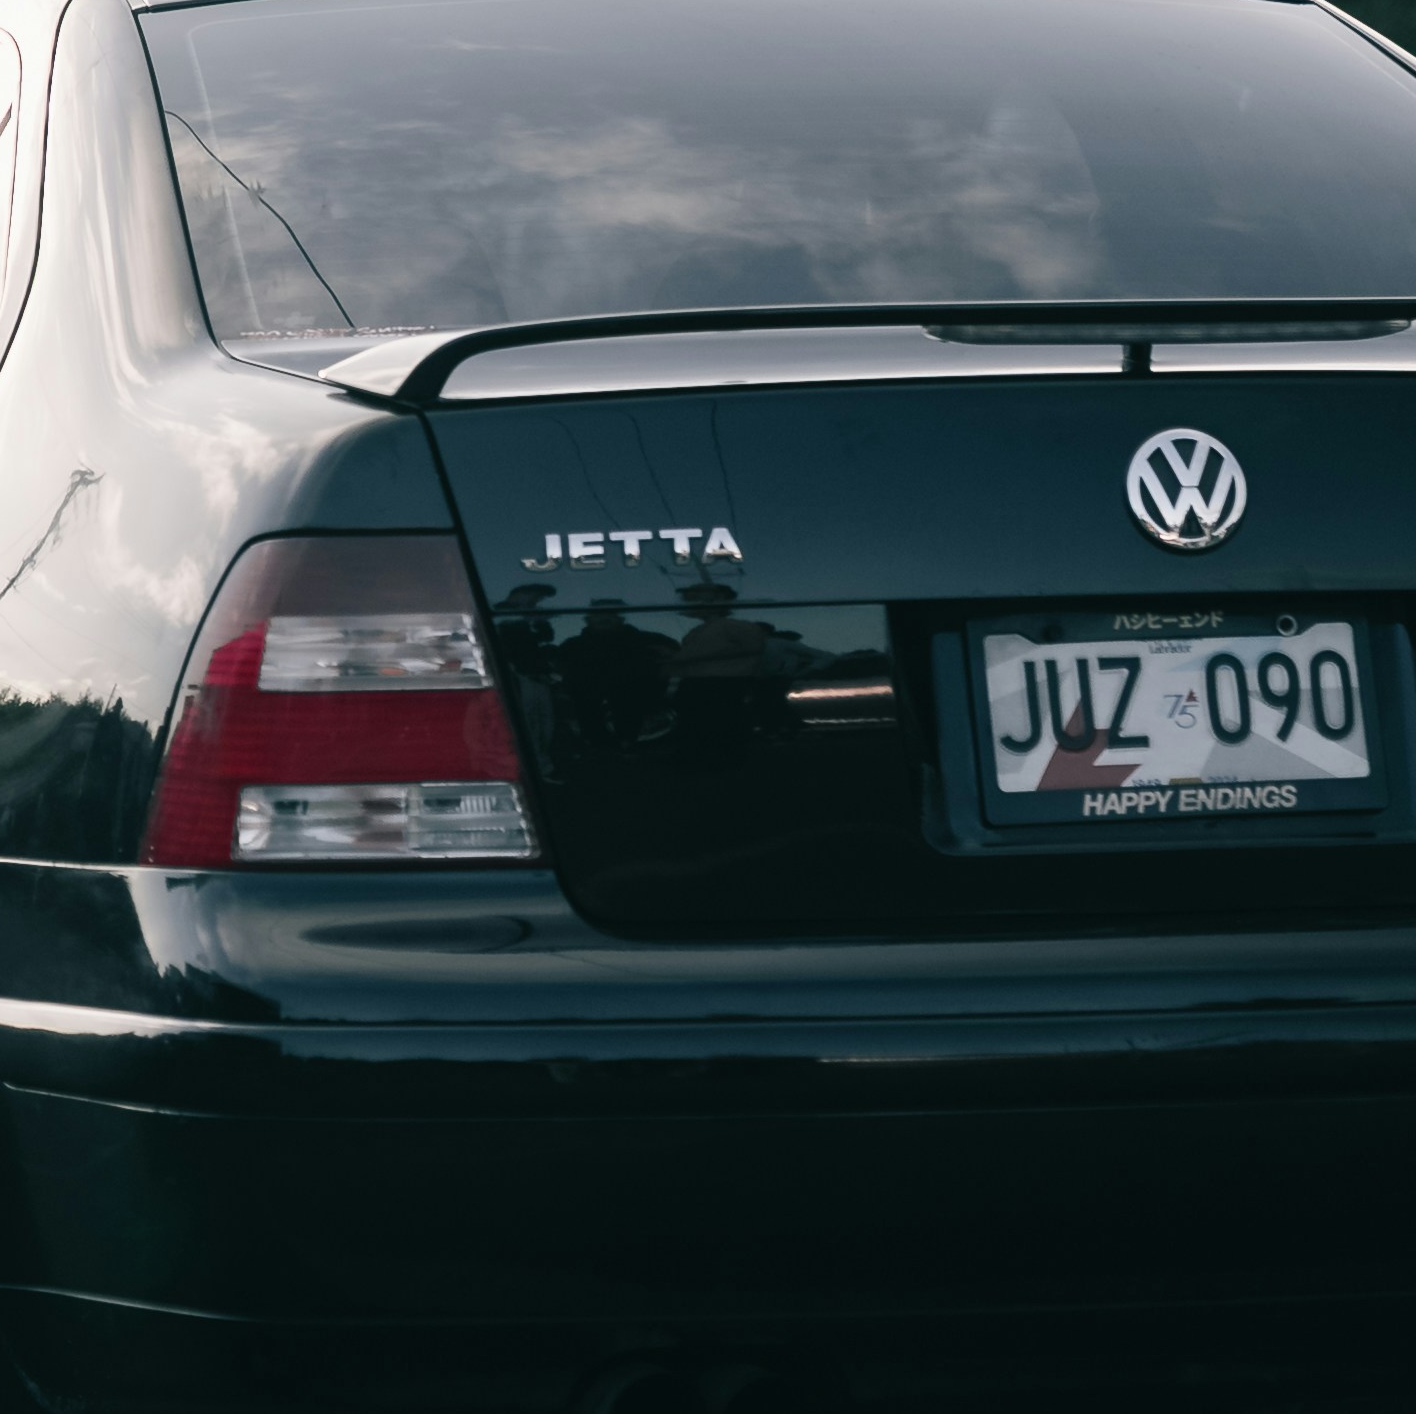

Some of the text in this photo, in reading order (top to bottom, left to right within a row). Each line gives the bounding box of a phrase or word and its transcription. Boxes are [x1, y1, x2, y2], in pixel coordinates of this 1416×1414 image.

[1126, 428, 1248, 551] VW
[520, 527, 744, 572] JETTA
[1000, 649, 1356, 755] JUZ 090
[1162, 693, 1200, 730] 75
[1083, 785, 1299, 817] HAPPY ENDINGS
